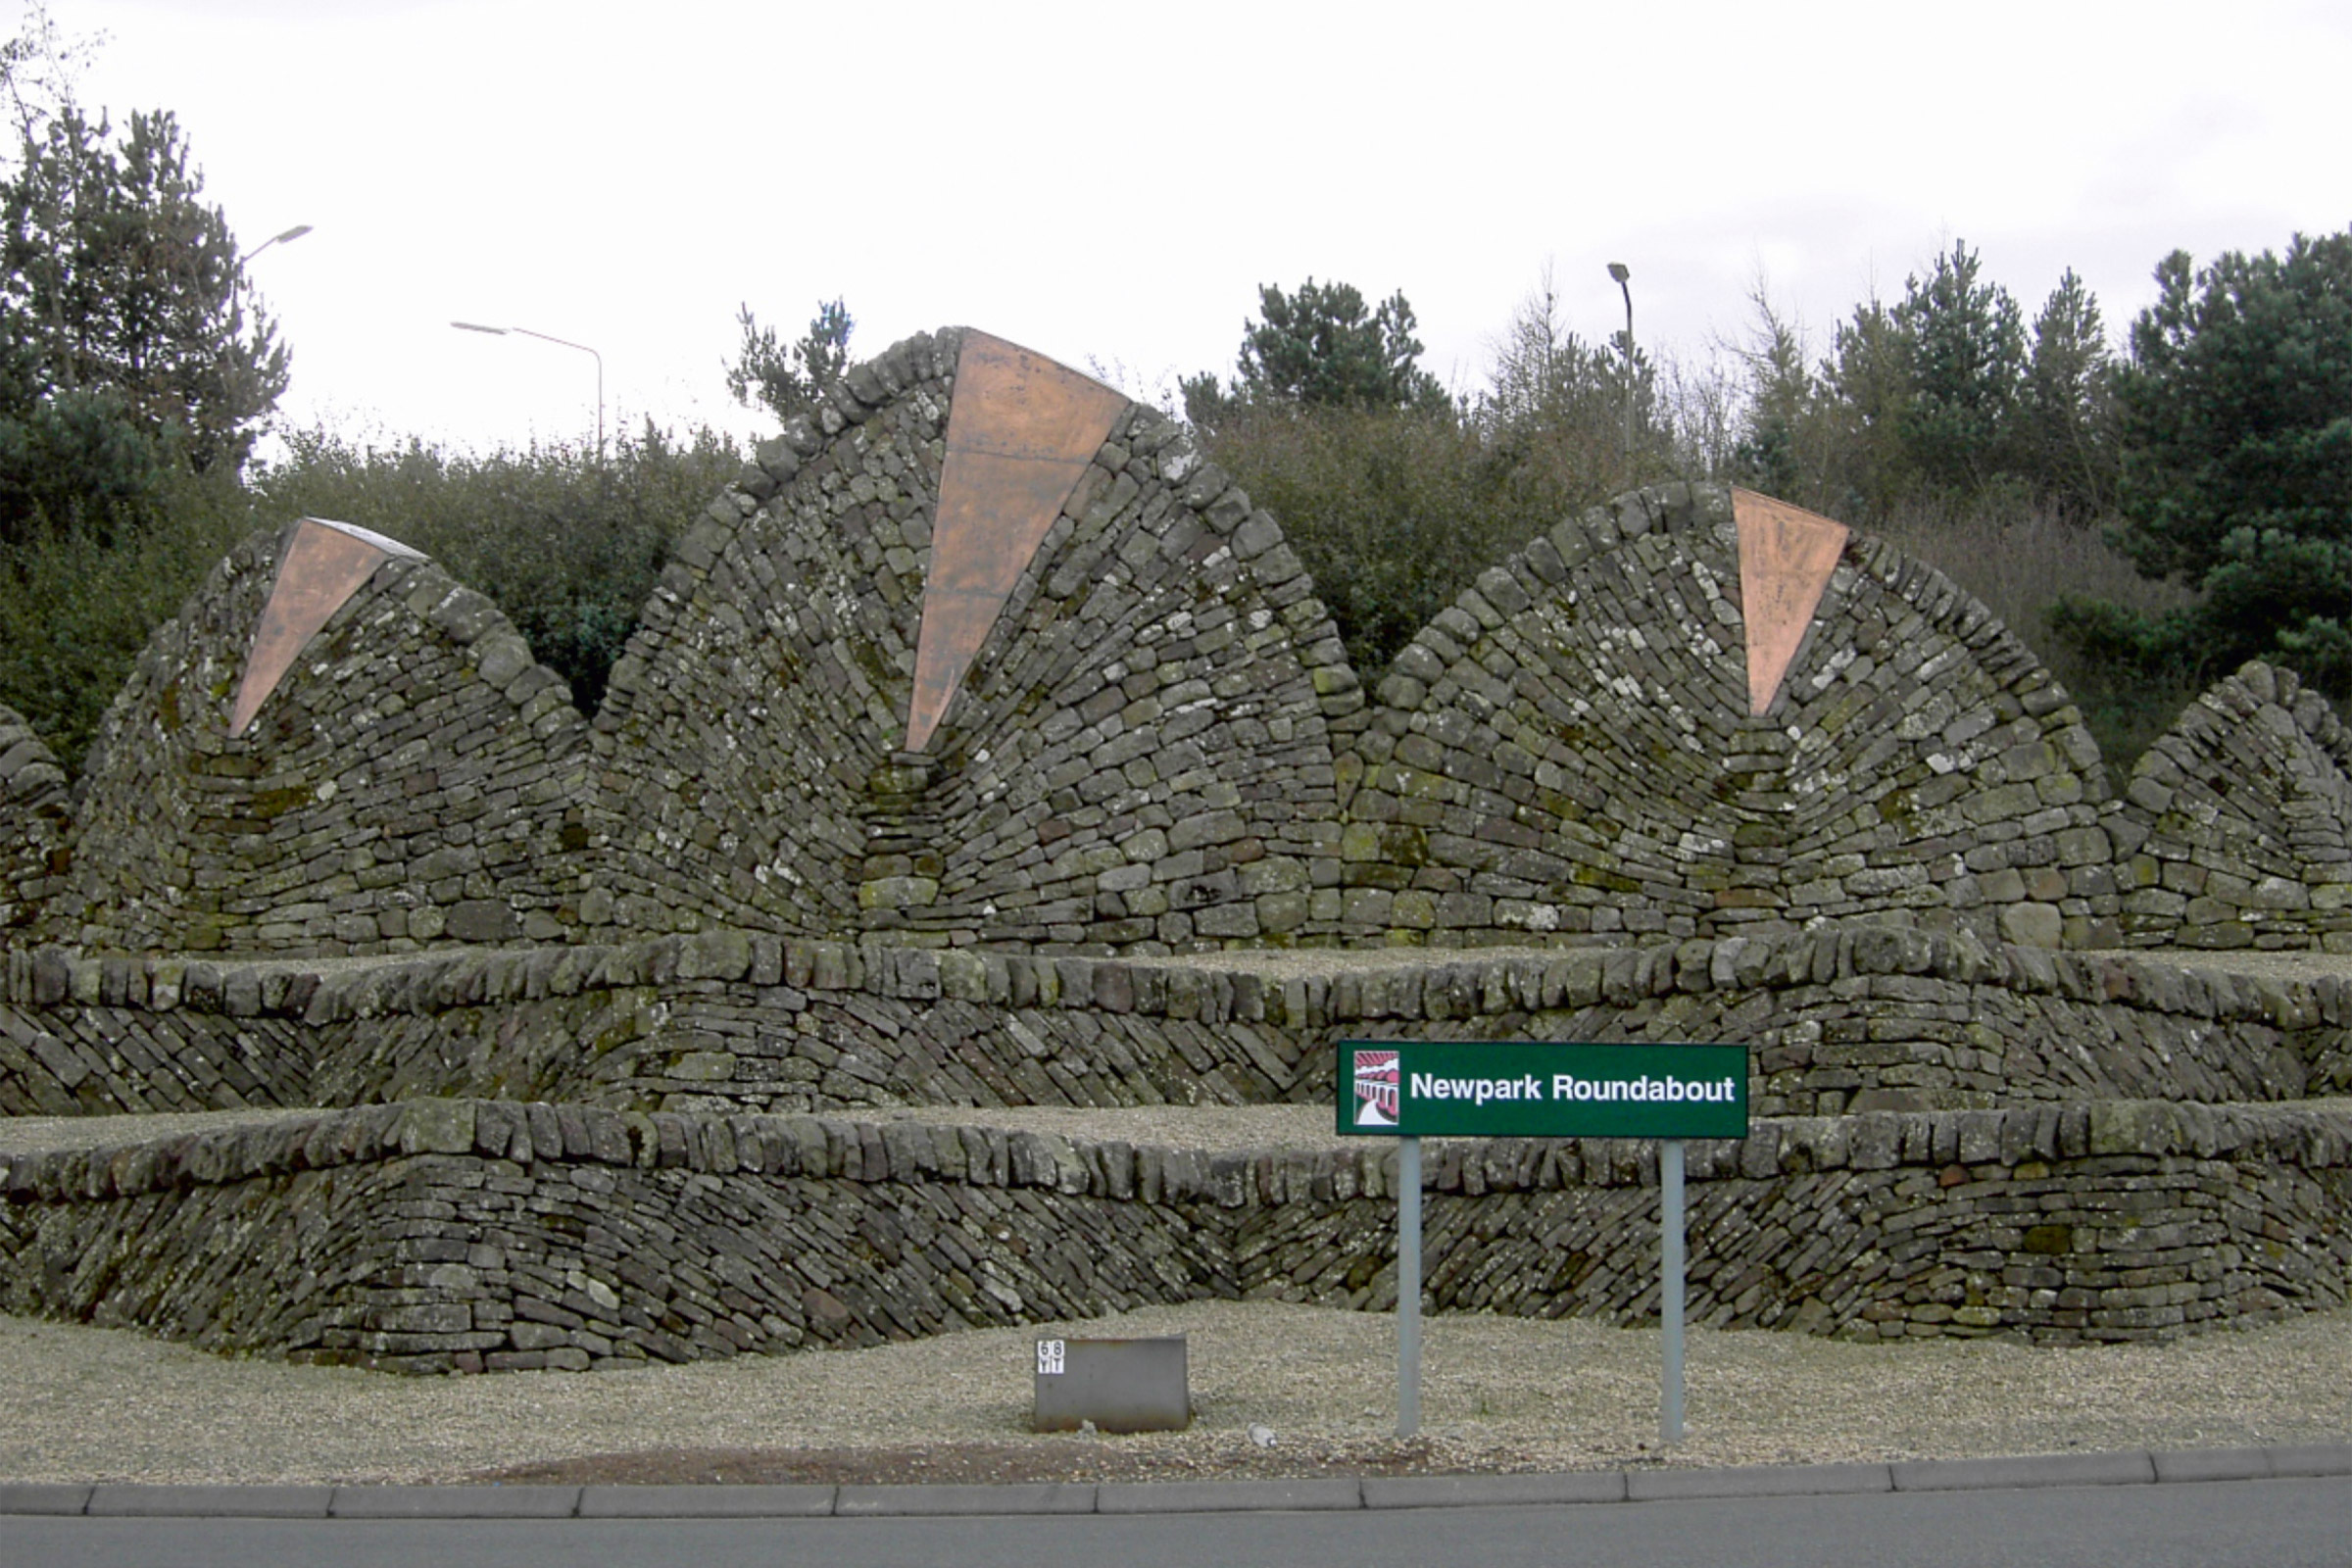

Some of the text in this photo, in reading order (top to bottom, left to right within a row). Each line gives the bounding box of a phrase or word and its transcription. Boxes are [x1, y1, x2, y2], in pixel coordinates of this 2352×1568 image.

[1410, 1072, 1736, 1105] Newpark Roundabout
[1040, 1342, 1063, 1356] 68
[1040, 1358, 1061, 1372] YT
